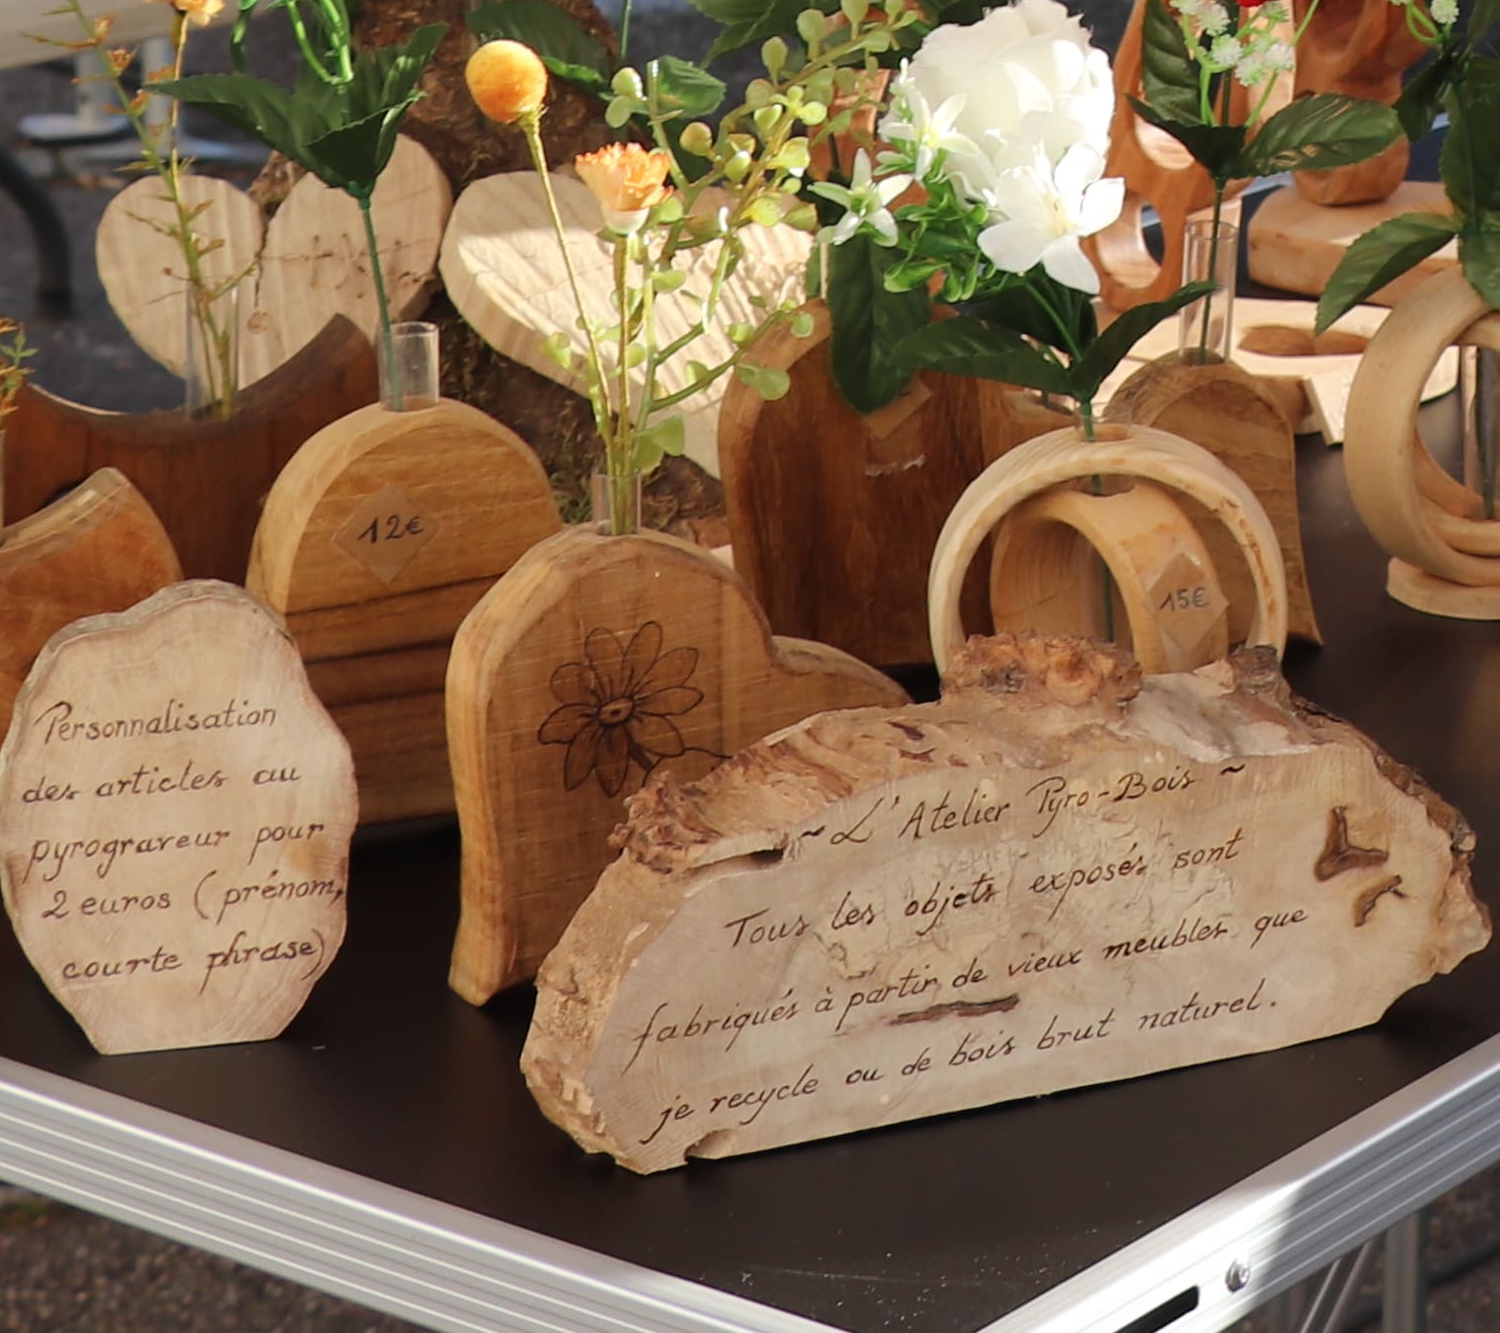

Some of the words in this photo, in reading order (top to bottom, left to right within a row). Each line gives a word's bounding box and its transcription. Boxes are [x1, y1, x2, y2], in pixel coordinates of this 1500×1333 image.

[358, 514, 424, 544] 12€
[1159, 586, 1211, 613] 15€
[34, 700, 277, 746] Personnalisation
[22, 777, 79, 805] des
[96, 759, 228, 797] articles
[253, 765, 302, 784] au
[1025, 762, 1195, 838] Pyro-Bois
[22, 830, 230, 883] pyrograveur
[249, 822, 325, 866] pour
[41, 889, 69, 920] 2
[81, 893, 171, 915] euros
[723, 907, 809, 949] Tous
[832, 889, 877, 931] les
[904, 875, 996, 936] objets
[1030, 842, 1150, 923] exposés
[1173, 828, 1242, 869] sont
[63, 946, 183, 981] courte
[623, 988, 801, 1078] fabriqués
[815, 985, 836, 1013] à
[835, 963, 939, 1032] partir
[952, 952, 988, 988] de
[1007, 946, 1085, 978] vieux
[1103, 918, 1228, 961] meubles
[1250, 908, 1307, 950] que
[639, 1095, 695, 1146] je
[708, 1063, 819, 1126] recycle
[845, 1063, 884, 1086] ou
[901, 1043, 934, 1078] de
[948, 1030, 1017, 1071] bois
[1037, 1007, 1115, 1053] brut
